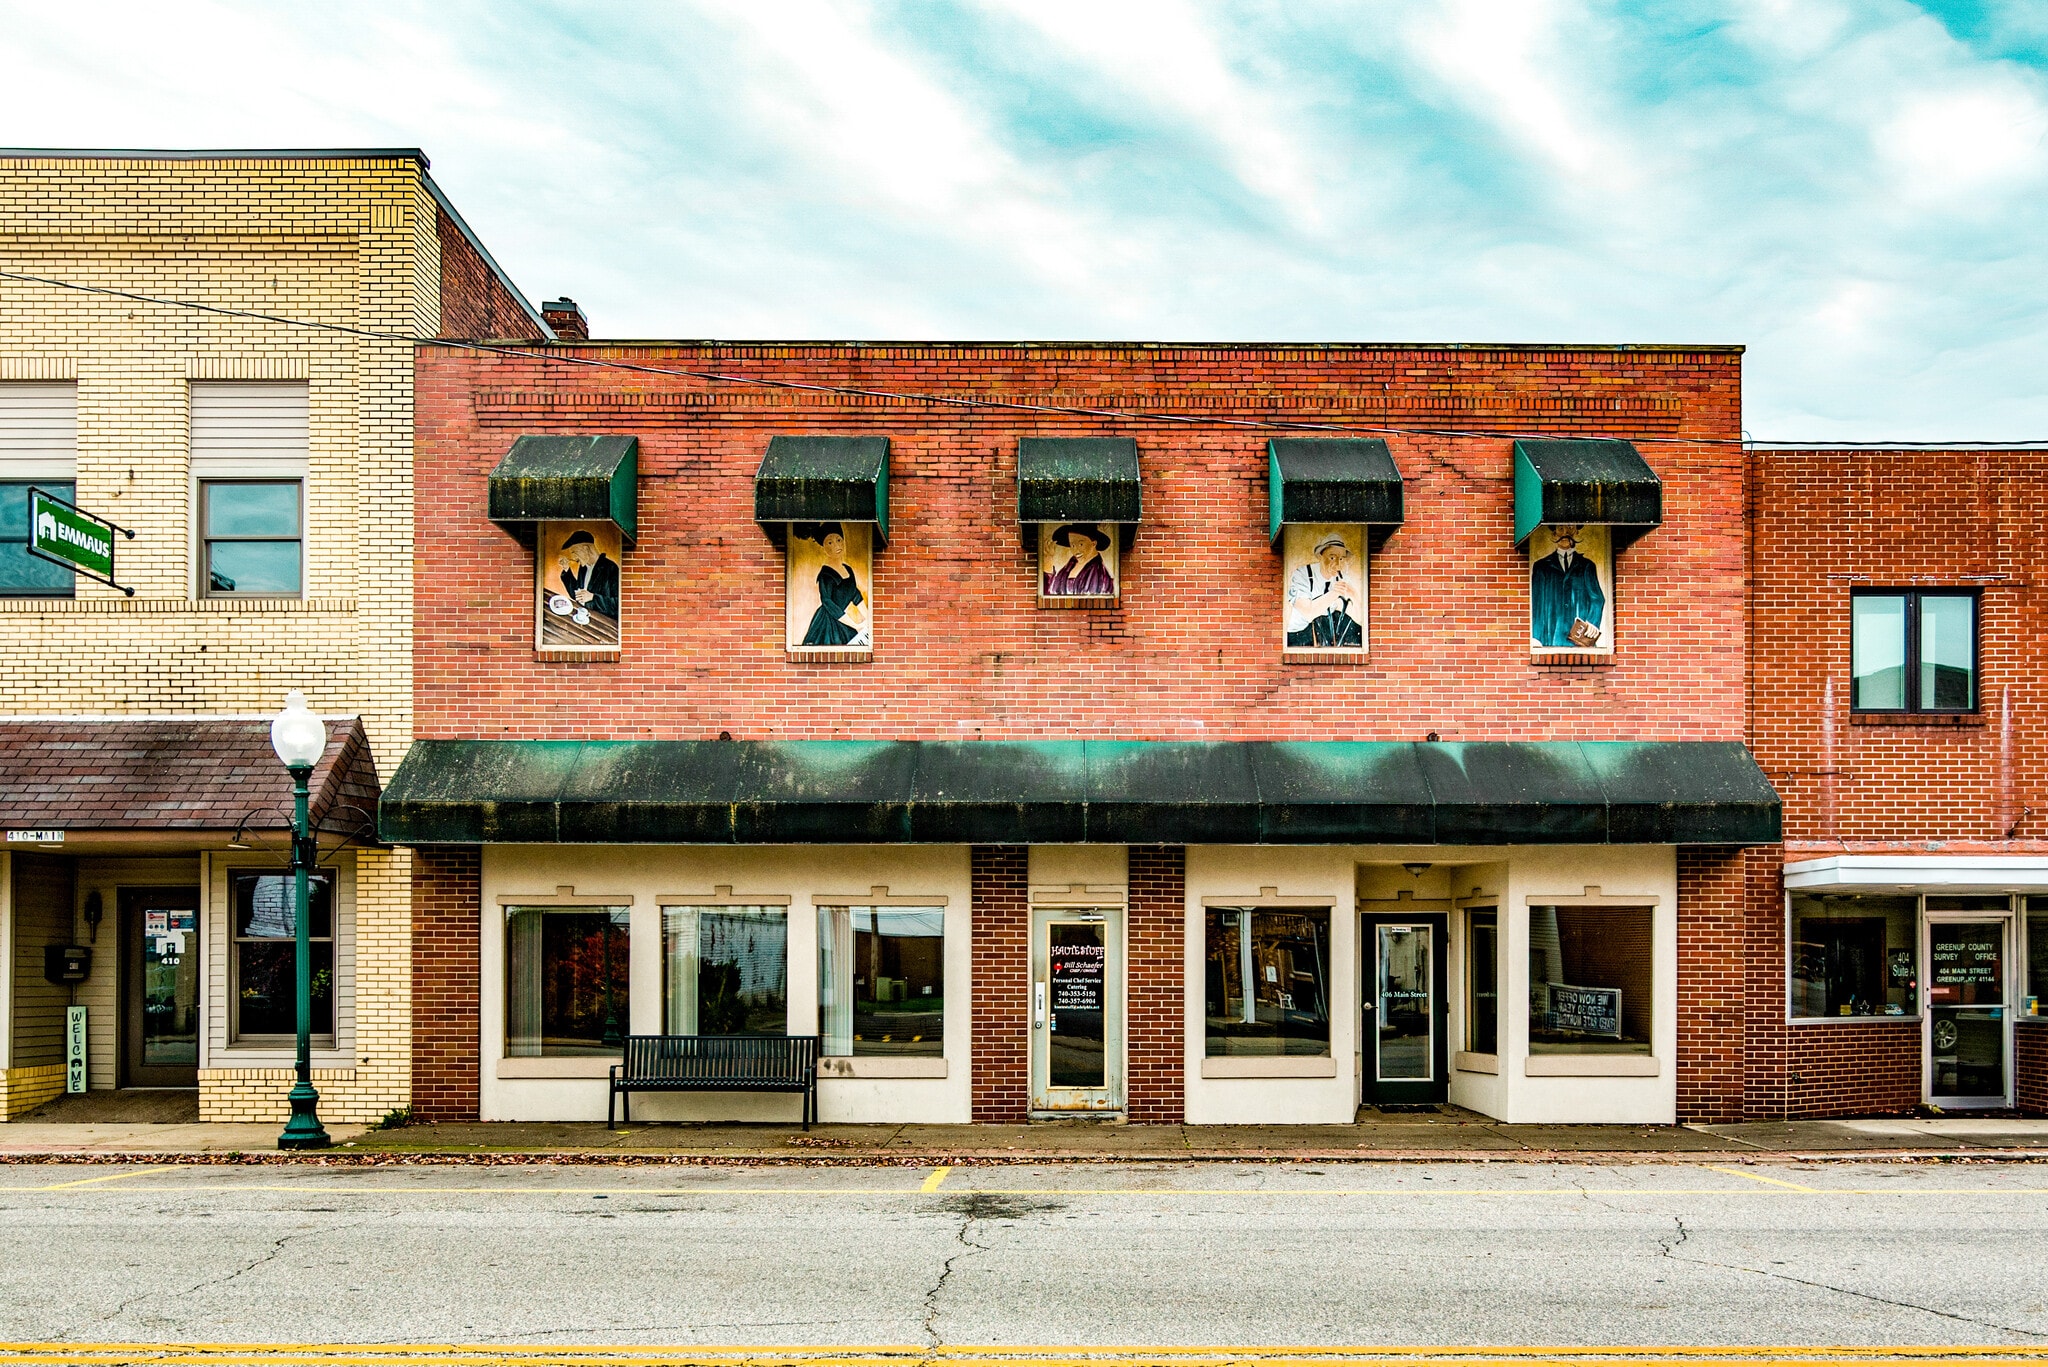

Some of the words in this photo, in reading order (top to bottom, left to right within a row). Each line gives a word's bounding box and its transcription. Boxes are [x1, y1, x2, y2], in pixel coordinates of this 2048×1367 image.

[58, 522, 109, 558] EMMAUS
[8, 831, 63, 840] 410-MAIN
[161, 957, 180, 965] 410
[1898, 952, 1909, 963] 404
[1076, 962, 1103, 970] Schaefer
[1893, 965, 1908, 976] Suite
[1910, 966, 1915, 976] A
